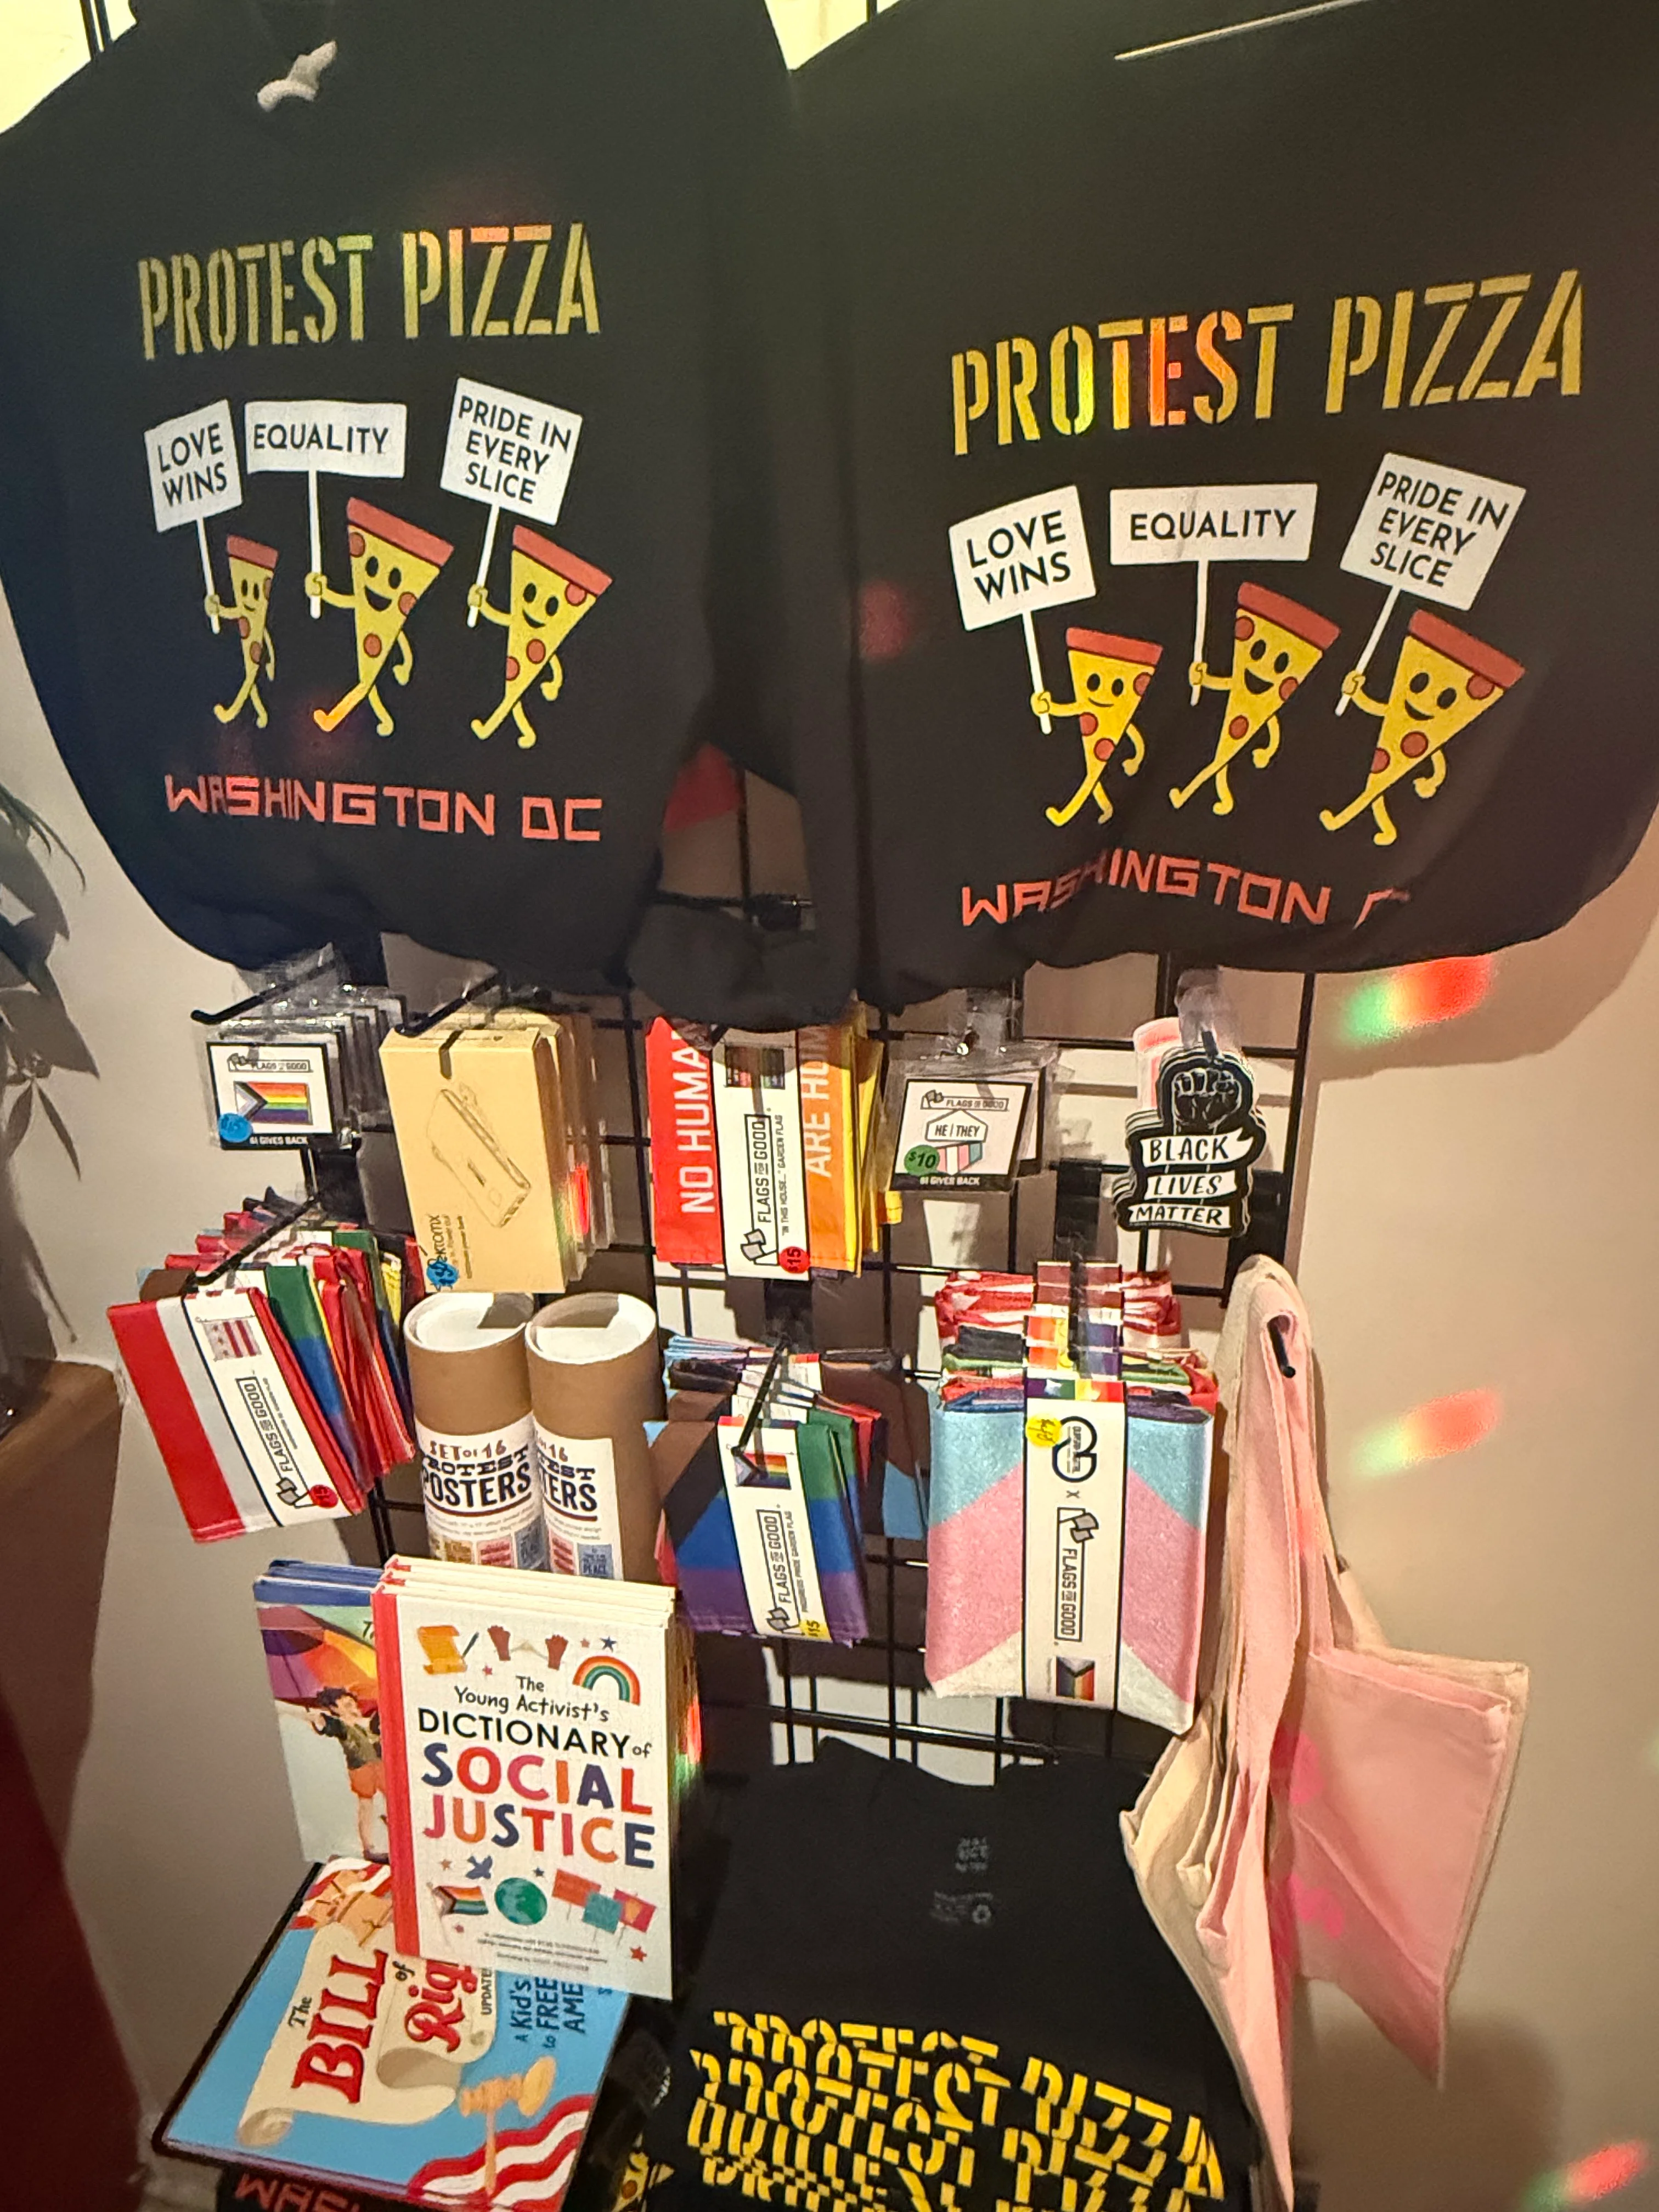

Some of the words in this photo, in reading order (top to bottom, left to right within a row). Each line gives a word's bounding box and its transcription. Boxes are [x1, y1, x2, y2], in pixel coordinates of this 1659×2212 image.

[138, 234, 373, 360] PROTEST
[403, 223, 600, 339] PIZZA
[951, 304, 1293, 455] PROTEST
[1325, 269, 1583, 414] PIZZA
[253, 424, 389, 455] EQUALITY
[459, 396, 531, 436] PRIDE
[541, 420, 572, 452] IN
[157, 422, 223, 473] LOVE
[466, 431, 550, 476] EVERY
[162, 461, 227, 507] WINS
[465, 462, 537, 504] SLICE
[1377, 470, 1461, 516] PRIDE
[1474, 495, 1510, 529] IN
[967, 510, 1067, 567] LOVE
[1130, 509, 1297, 541] EQUALITY
[1378, 510, 1477, 557] EVERY
[974, 550, 1073, 604] WINS
[1370, 542, 1453, 588] SLICE
[164, 774, 496, 836] WASHINGTON
[522, 796, 602, 842] DC
[961, 847, 1331, 927] WASHINGTON
[752, 1121, 768, 1160] GOOD
[803, 1112, 832, 1178] ARE
[934, 1125, 947, 1137] HE
[956, 1125, 980, 1137] THEY
[1150, 1135, 1229, 1163] BLACK
[908, 1150, 936, 1169] $10
[679, 1166, 715, 1214] NO
[755, 1178, 772, 1223] FLAGS
[1153, 1175, 1223, 1196] LIVES
[1136, 1205, 1223, 1226] MATTER
[244, 1383, 268, 1418] GOOD
[265, 1432, 294, 1472] FLAGS
[481, 1440, 507, 1459] 16
[549, 1444, 568, 1462] 16
[764, 1515, 782, 1550] GOOD
[772, 1564, 792, 1604] FLAGS
[1062, 1548, 1078, 1590] FLAGS
[1060, 1602, 1076, 1636] GOOD
[454, 1686, 509, 1713] Young
[516, 1694, 610, 1723] Activist's
[515, 1675, 544, 1693] The
[418, 1707, 630, 1758] DICTIONARY
[632, 1742, 653, 1758] of
[421, 1742, 653, 1816] SOCIAL
[422, 1794, 656, 1869] JUSTICE
[392, 1960, 416, 1982] of
[287, 1996, 313, 2028] The
[509, 1979, 533, 2030] Kid's
[534, 1977, 560, 2030] FREE
[561, 1982, 586, 2035] AME
[290, 1949, 389, 2104] BILL
[515, 2034, 529, 2042] A
[542, 2035, 556, 2049] to
